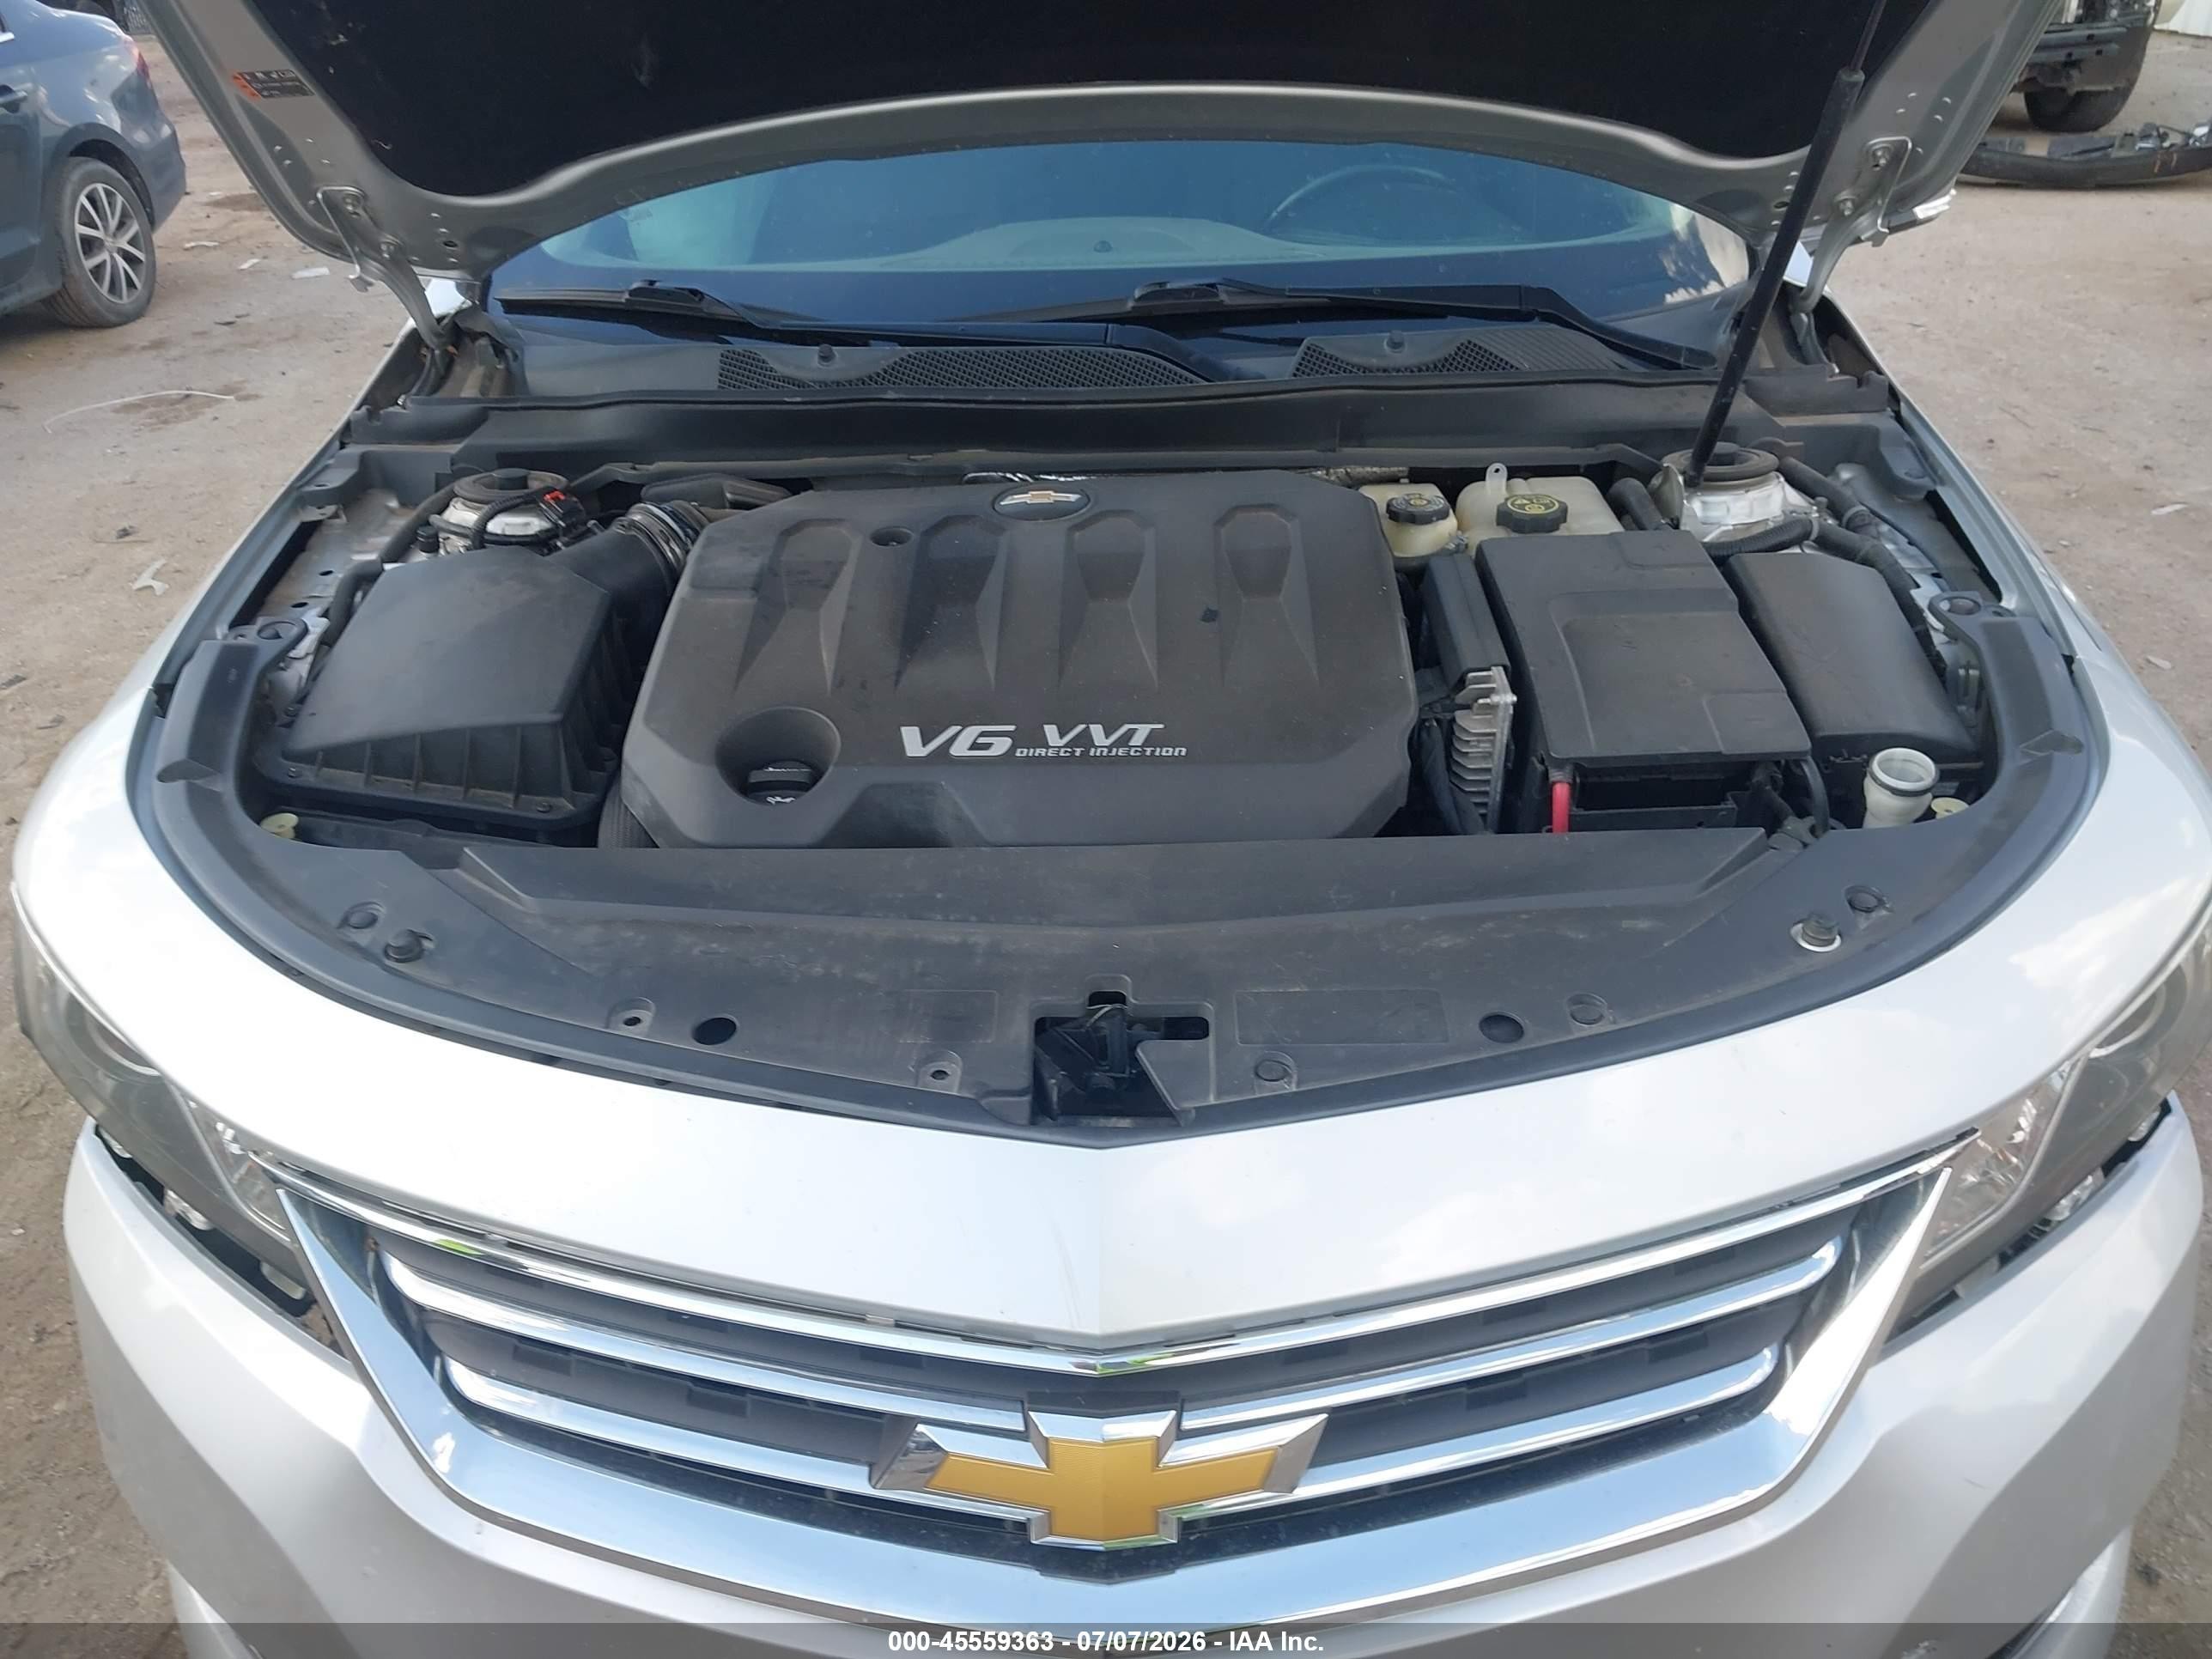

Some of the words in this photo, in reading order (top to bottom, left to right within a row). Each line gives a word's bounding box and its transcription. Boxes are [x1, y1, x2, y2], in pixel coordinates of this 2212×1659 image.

[900, 725, 1016, 758] V6
[1042, 723, 1165, 746] VVT
[1015, 747, 1085, 757] DIRECT
[1089, 747, 1188, 757] INJECTION
